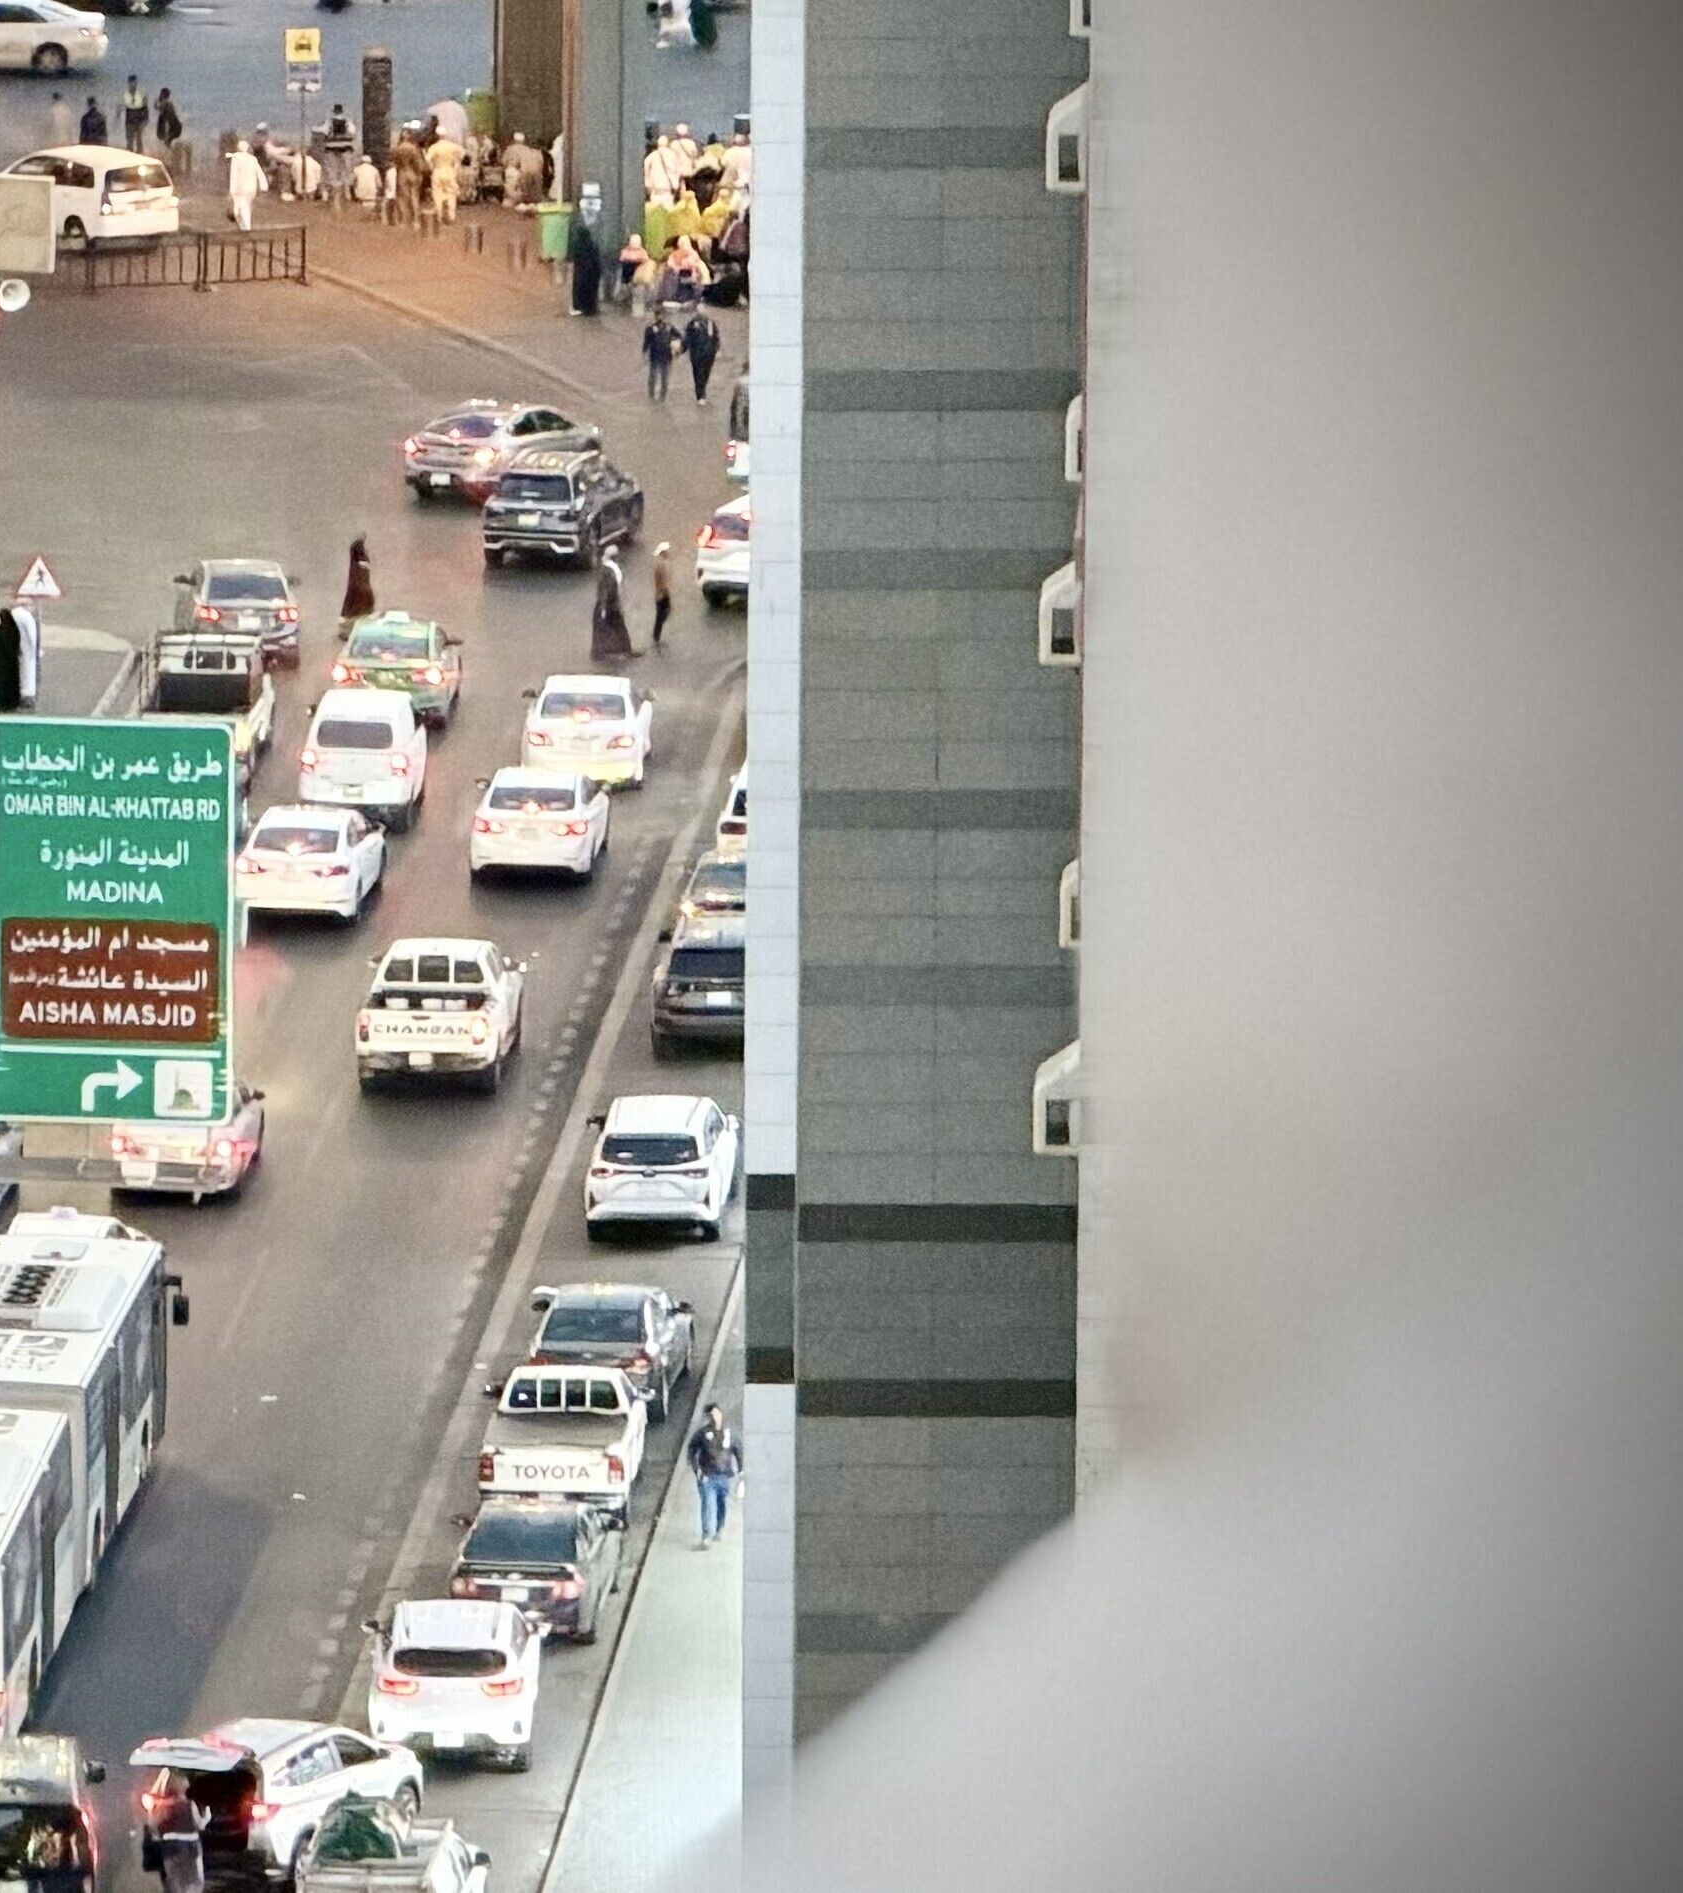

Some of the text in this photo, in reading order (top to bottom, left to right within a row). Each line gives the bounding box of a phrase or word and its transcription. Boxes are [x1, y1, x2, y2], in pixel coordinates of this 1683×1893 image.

[1, 743, 223, 783] طريق عمر بن الخطاب
[3, 793, 221, 822] OMAR BIN AL-KHATTAB RD
[40, 837, 189, 873] المدينة المنورة
[67, 879, 164, 904] MADINA
[10, 925, 101, 953] المؤمنين
[136, 934, 209, 956] مسجد
[57, 965, 125, 989] عائشة
[133, 968, 208, 997] السيدة
[19, 1001, 197, 1027] AISHA MASJID
[373, 1023, 470, 1036] CHANGAN
[511, 1464, 591, 1480] TOYOTA
